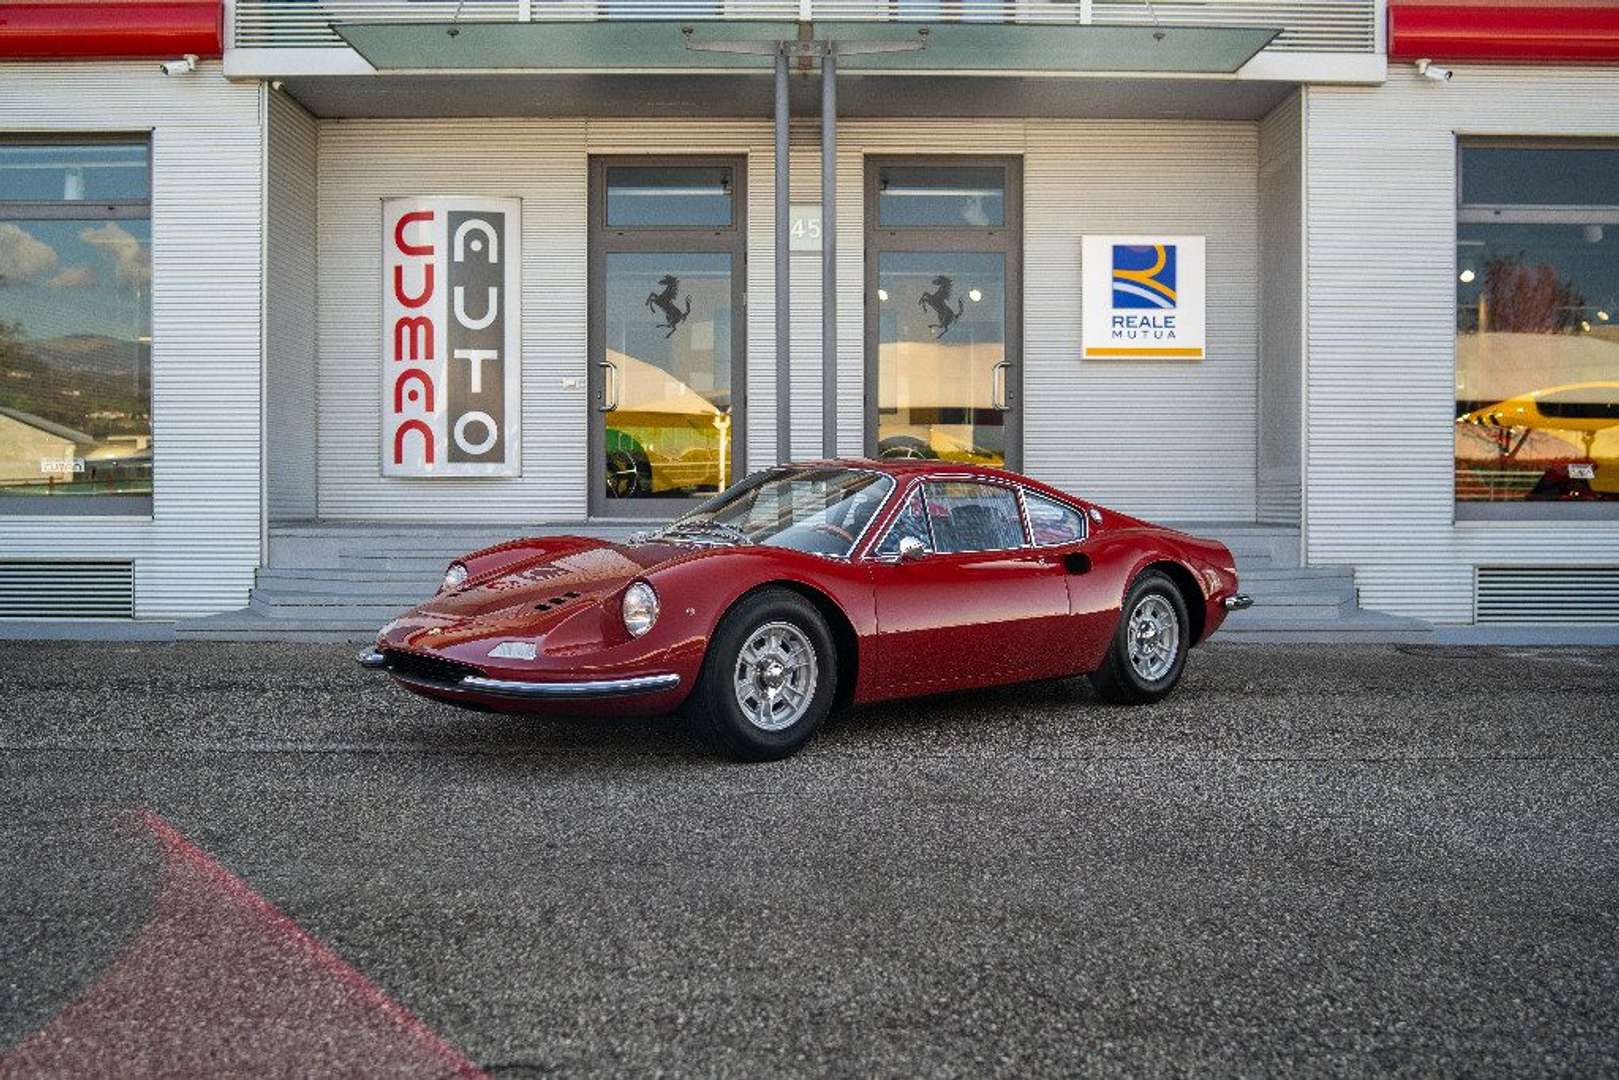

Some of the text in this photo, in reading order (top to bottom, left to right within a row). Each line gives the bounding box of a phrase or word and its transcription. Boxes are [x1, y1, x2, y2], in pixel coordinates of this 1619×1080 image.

[790, 218, 821, 239] 45
[1112, 315, 1176, 329] REALE
[453, 218, 498, 455] AUTO
[1112, 330, 1176, 340] MUTUA
